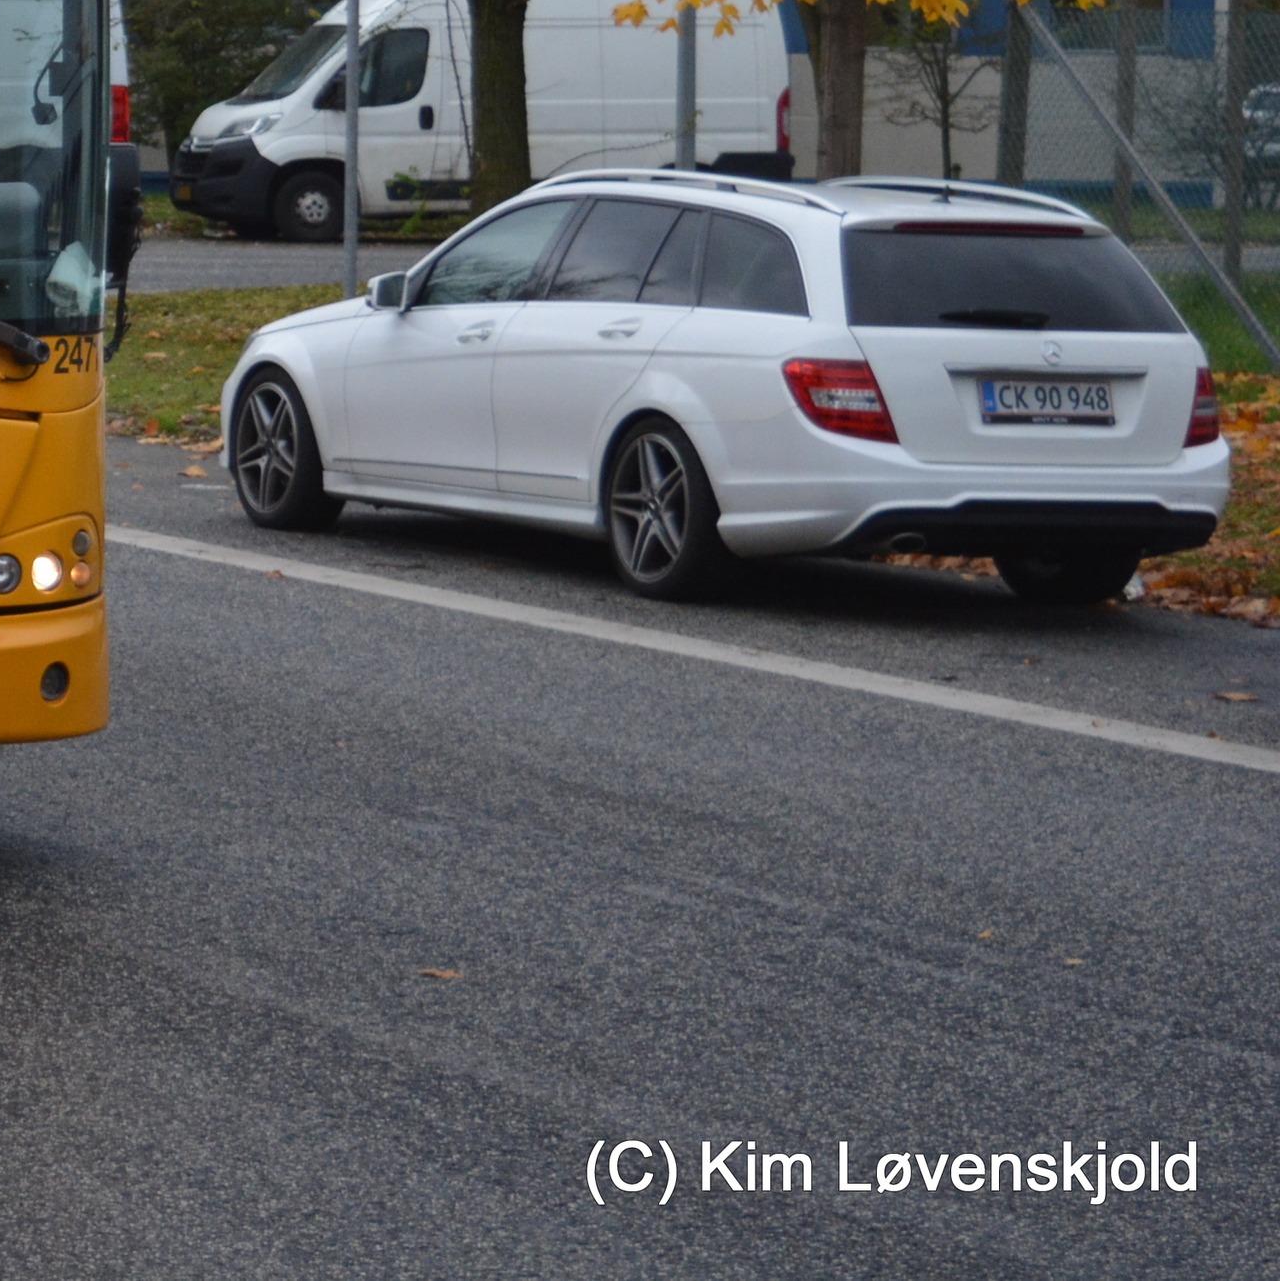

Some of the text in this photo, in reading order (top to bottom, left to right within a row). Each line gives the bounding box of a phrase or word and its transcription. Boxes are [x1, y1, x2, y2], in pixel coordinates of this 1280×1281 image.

[999, 385, 1109, 411] CK 90 948
